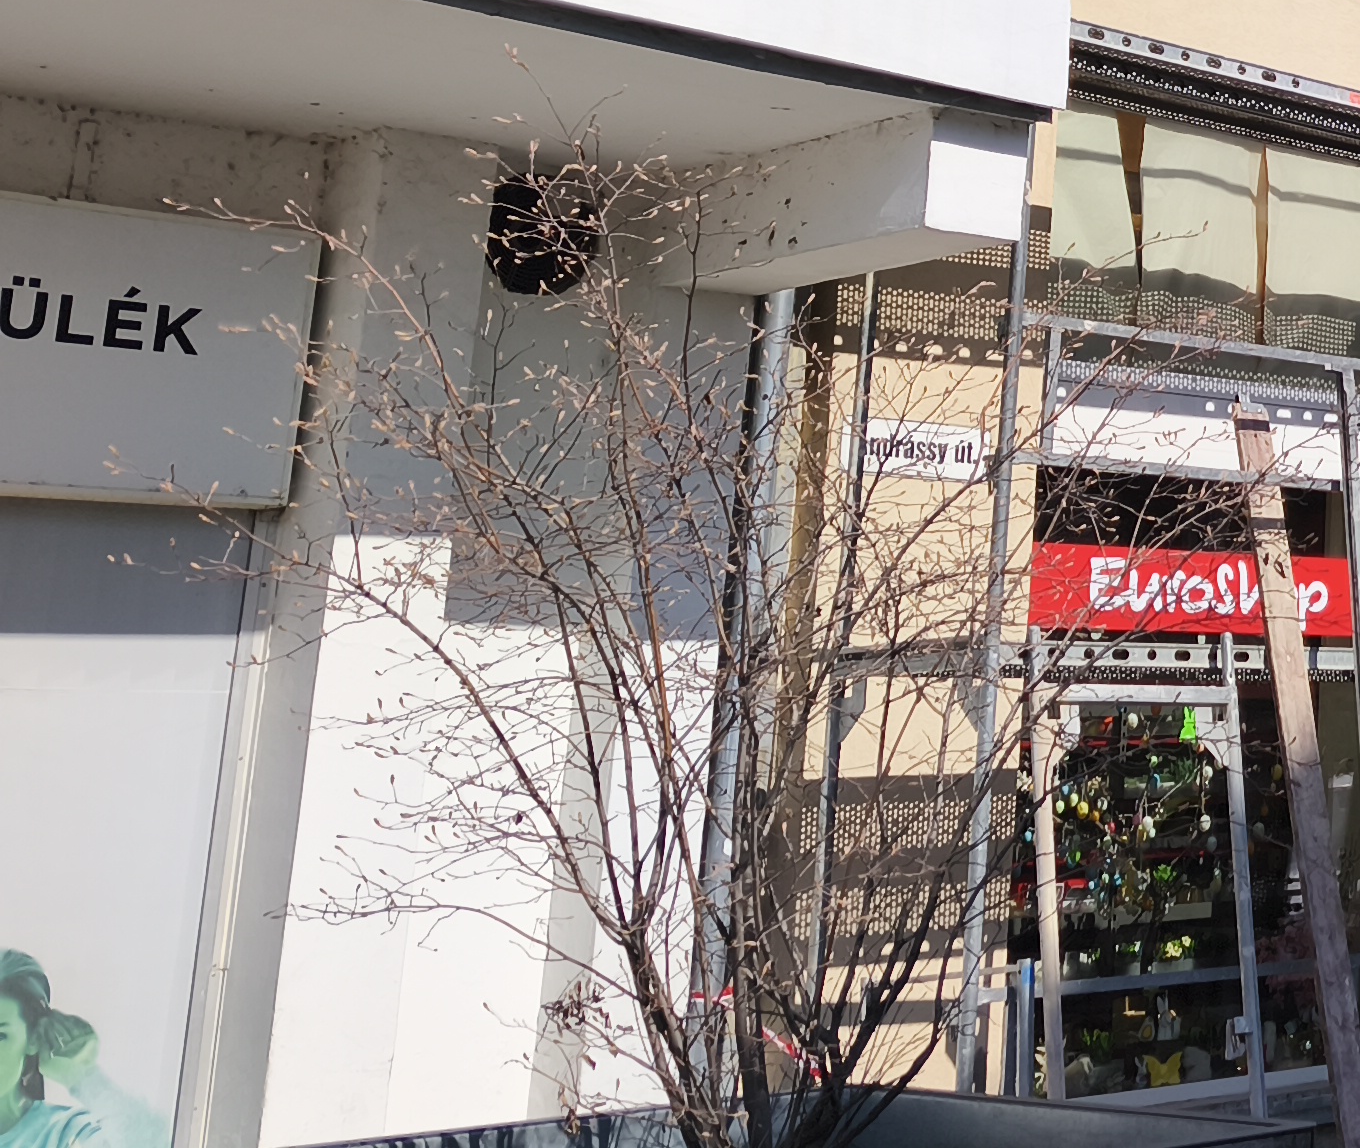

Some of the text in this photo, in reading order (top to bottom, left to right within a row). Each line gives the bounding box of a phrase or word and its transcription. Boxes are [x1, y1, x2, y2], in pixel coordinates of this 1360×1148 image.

[0, 275, 203, 356] ÜLÉK
[864, 432, 949, 465] ndrássy
[1089, 556, 1329, 632] EuroShp
